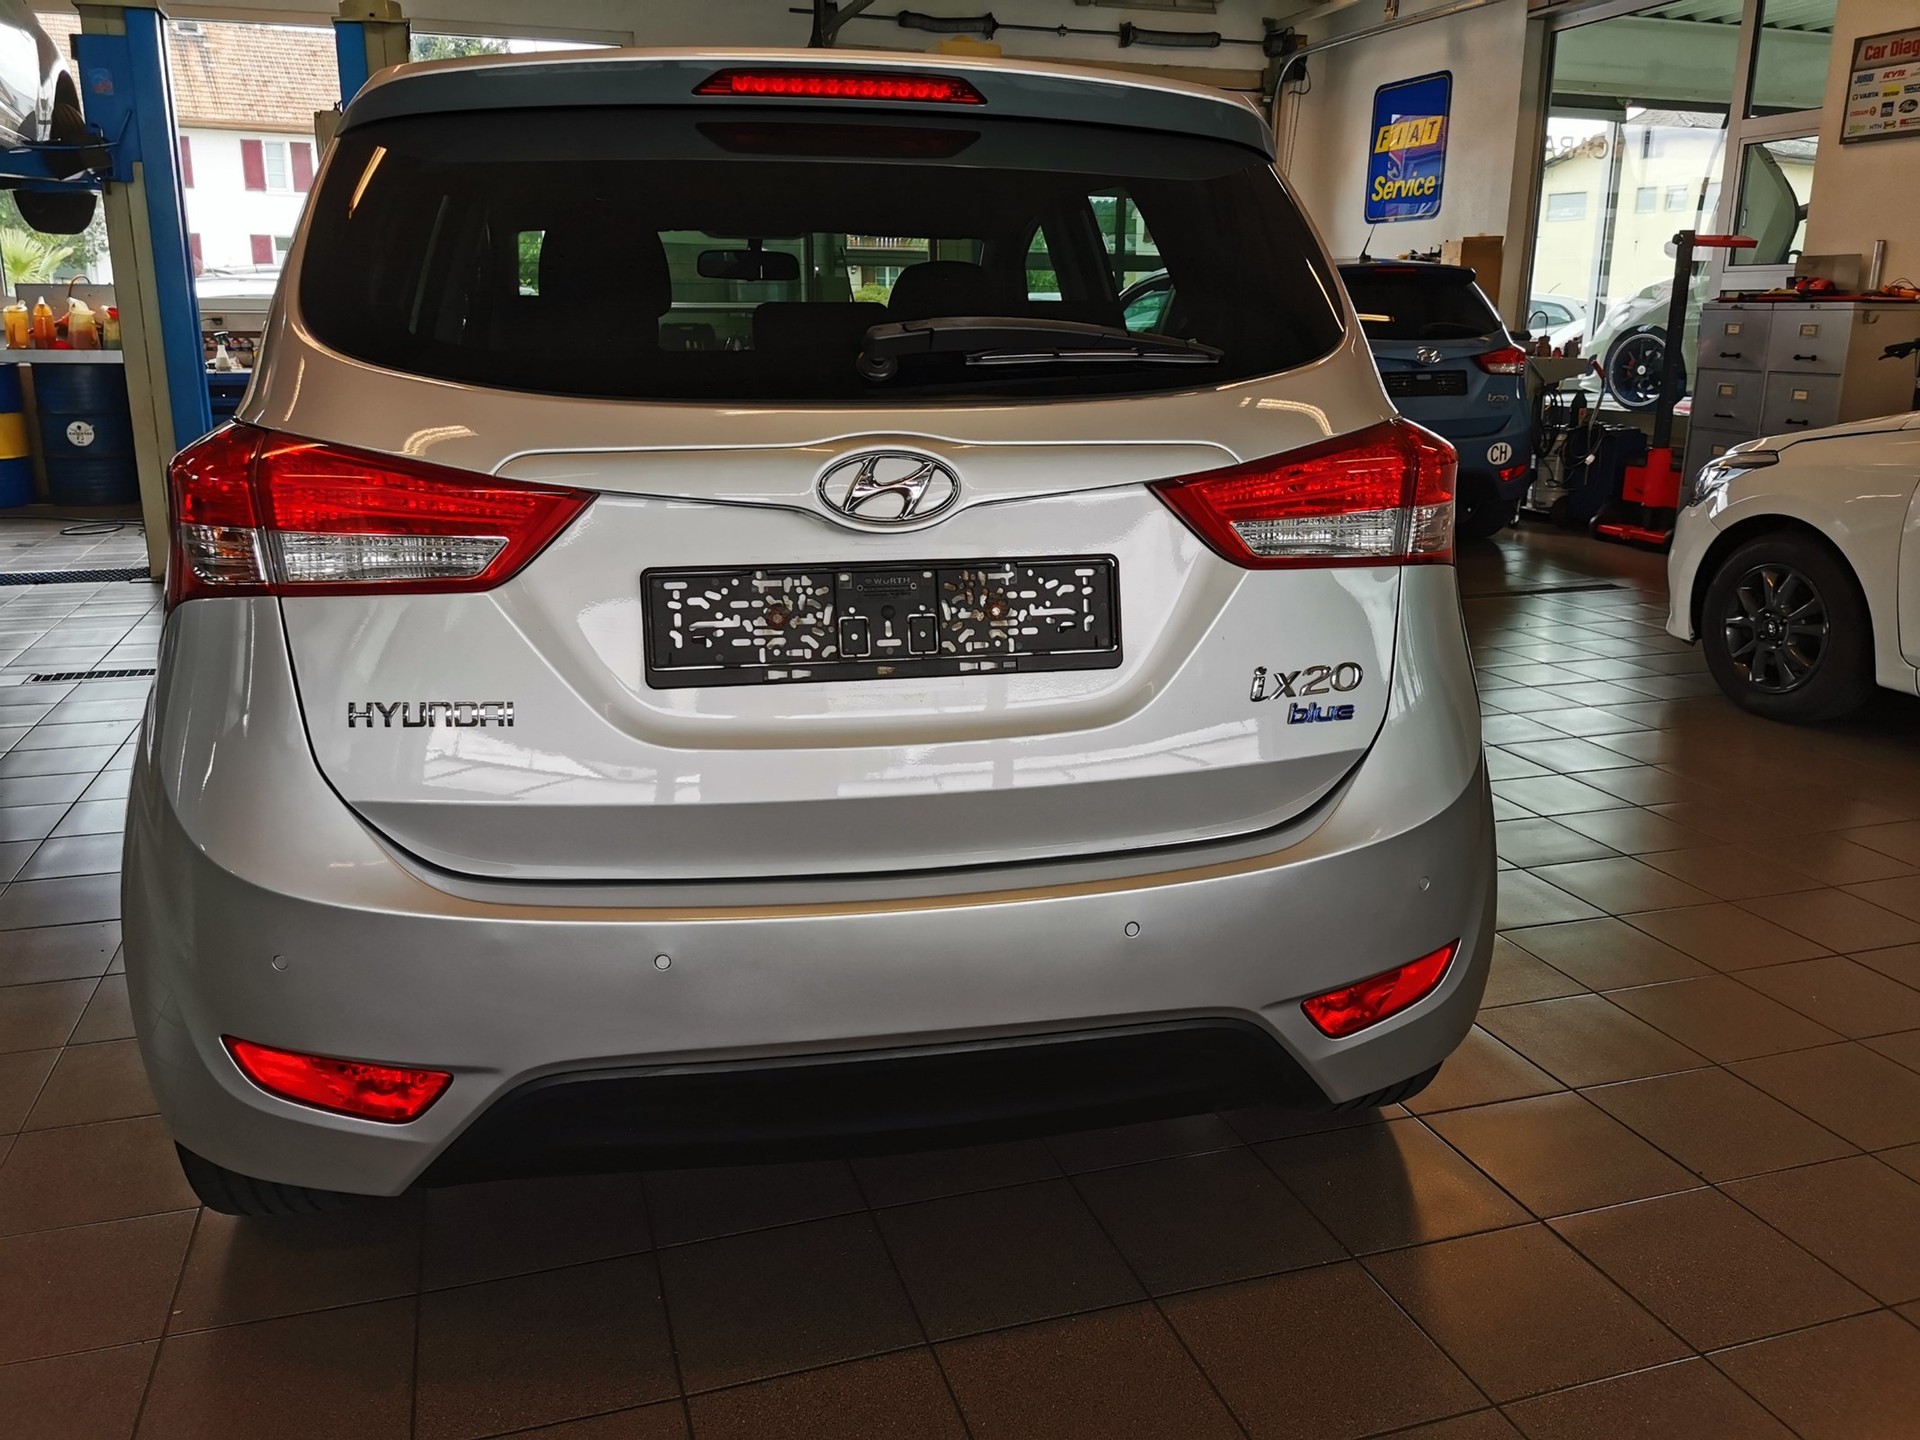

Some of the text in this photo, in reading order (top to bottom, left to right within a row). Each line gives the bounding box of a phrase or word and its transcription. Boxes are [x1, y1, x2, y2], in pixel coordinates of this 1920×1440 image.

[1864, 39, 1920, 60] Car Diag
[1377, 118, 1441, 151] FIAT
[1371, 171, 1436, 202] Service
[1490, 445, 1508, 462] CH
[1250, 662, 1363, 702] ix20
[348, 701, 514, 728] HYUNDAI
[1287, 702, 1355, 724] blue
